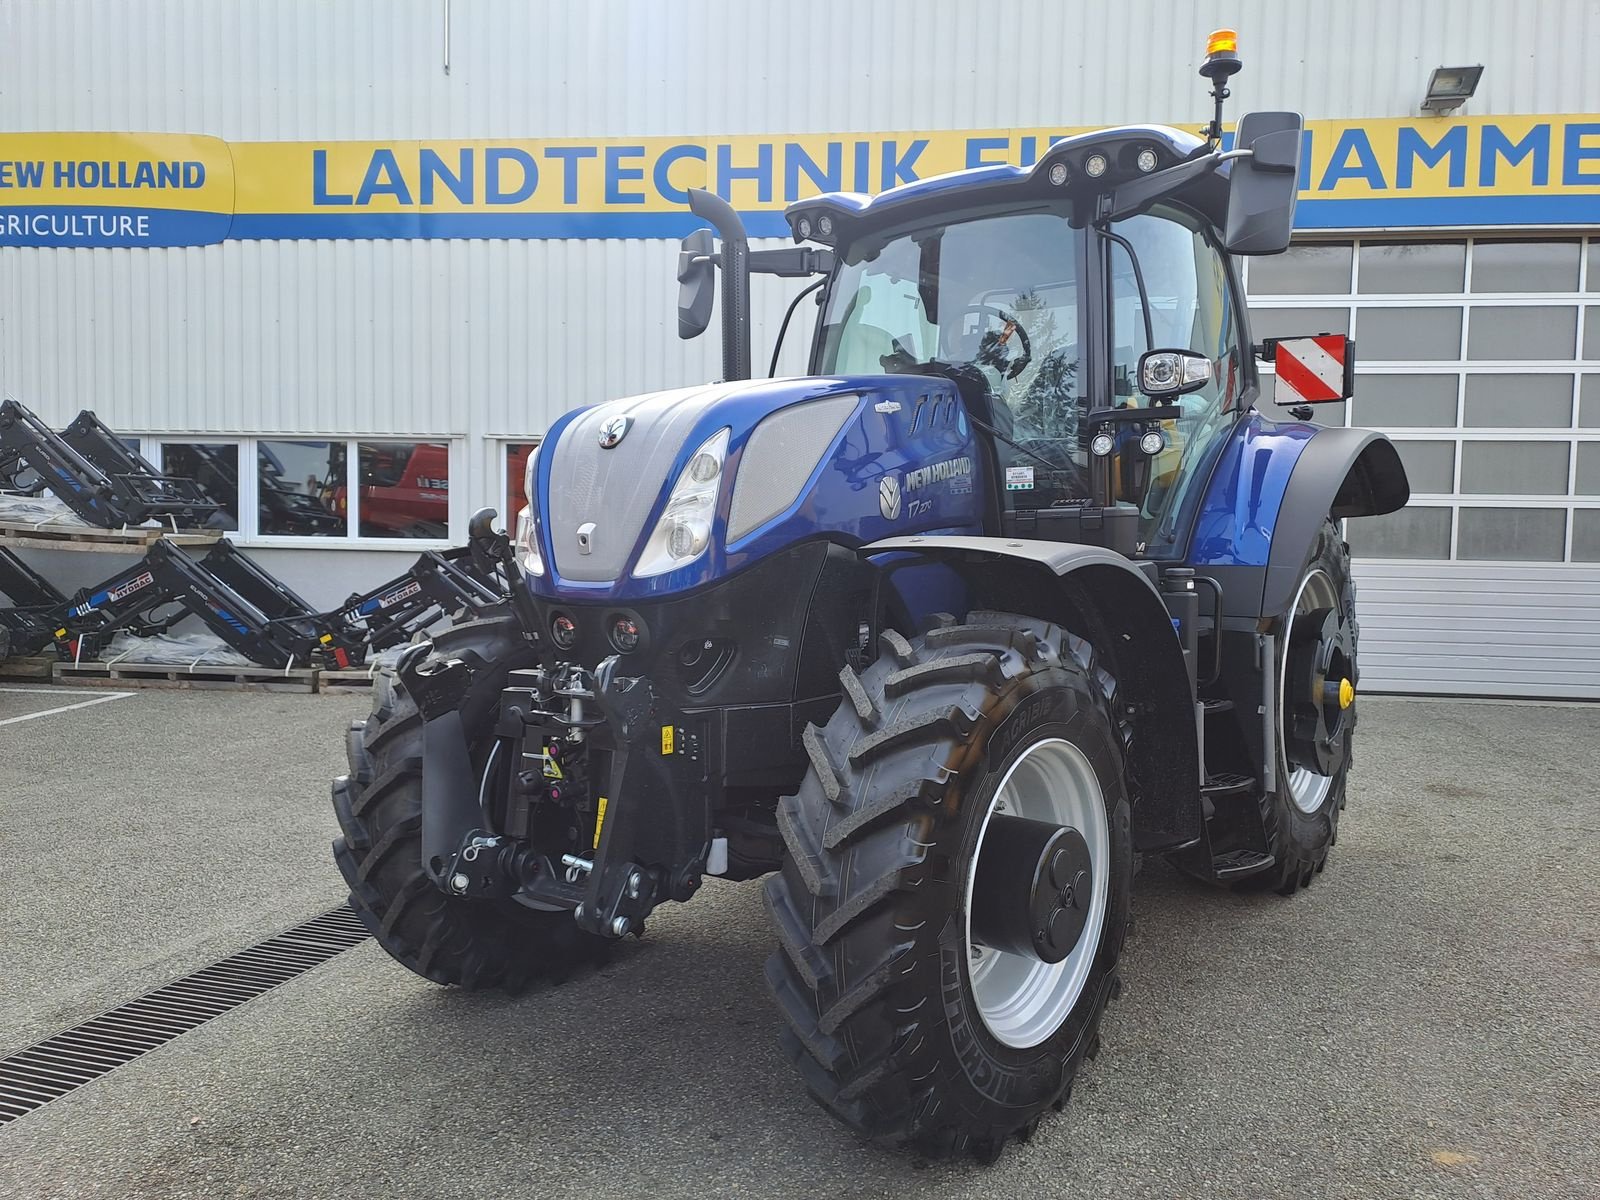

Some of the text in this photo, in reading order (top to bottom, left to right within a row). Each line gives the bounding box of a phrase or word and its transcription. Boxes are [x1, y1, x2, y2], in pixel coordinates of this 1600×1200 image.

[0, 161, 206, 189] EW HOLLAND
[312, 139, 930, 206] LANDTECHNIK
[906, 466, 931, 492] NEW
[931, 456, 971, 482] HOLLAND
[116, 577, 152, 598] HYDRAC
[190, 584, 208, 601] EURO
[386, 586, 419, 605] HYDRAC
